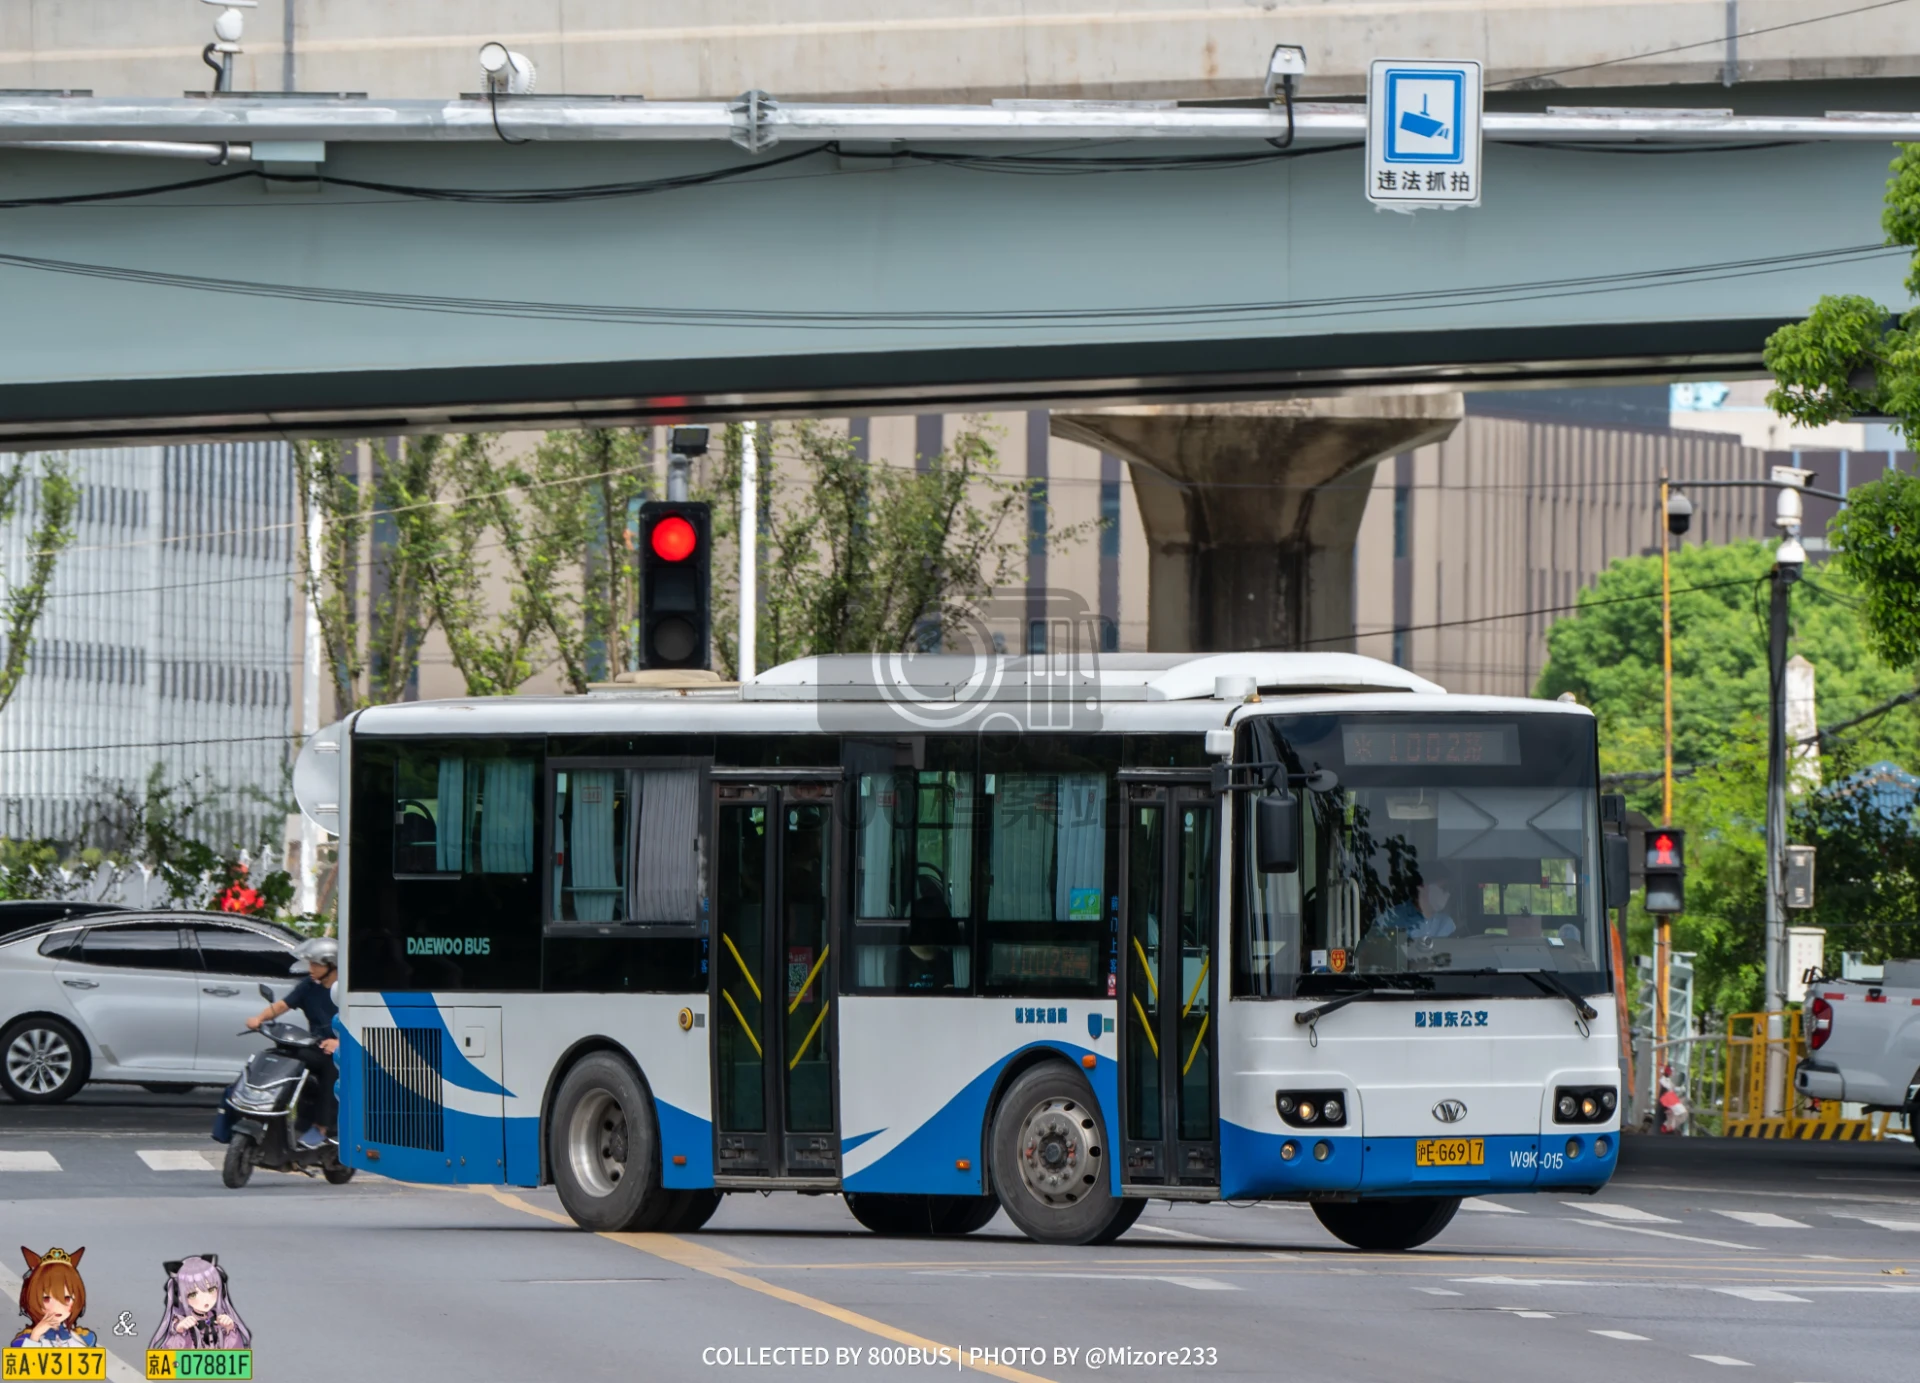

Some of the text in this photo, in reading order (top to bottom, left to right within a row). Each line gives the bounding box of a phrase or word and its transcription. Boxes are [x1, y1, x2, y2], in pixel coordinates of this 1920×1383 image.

[1377, 170, 1470, 192] 违法抓拍
[407, 937, 491, 955] DAEWOO BUS
[1428, 1011, 1489, 1027] 浦东公交
[1509, 1151, 1563, 1169] W9K-015
